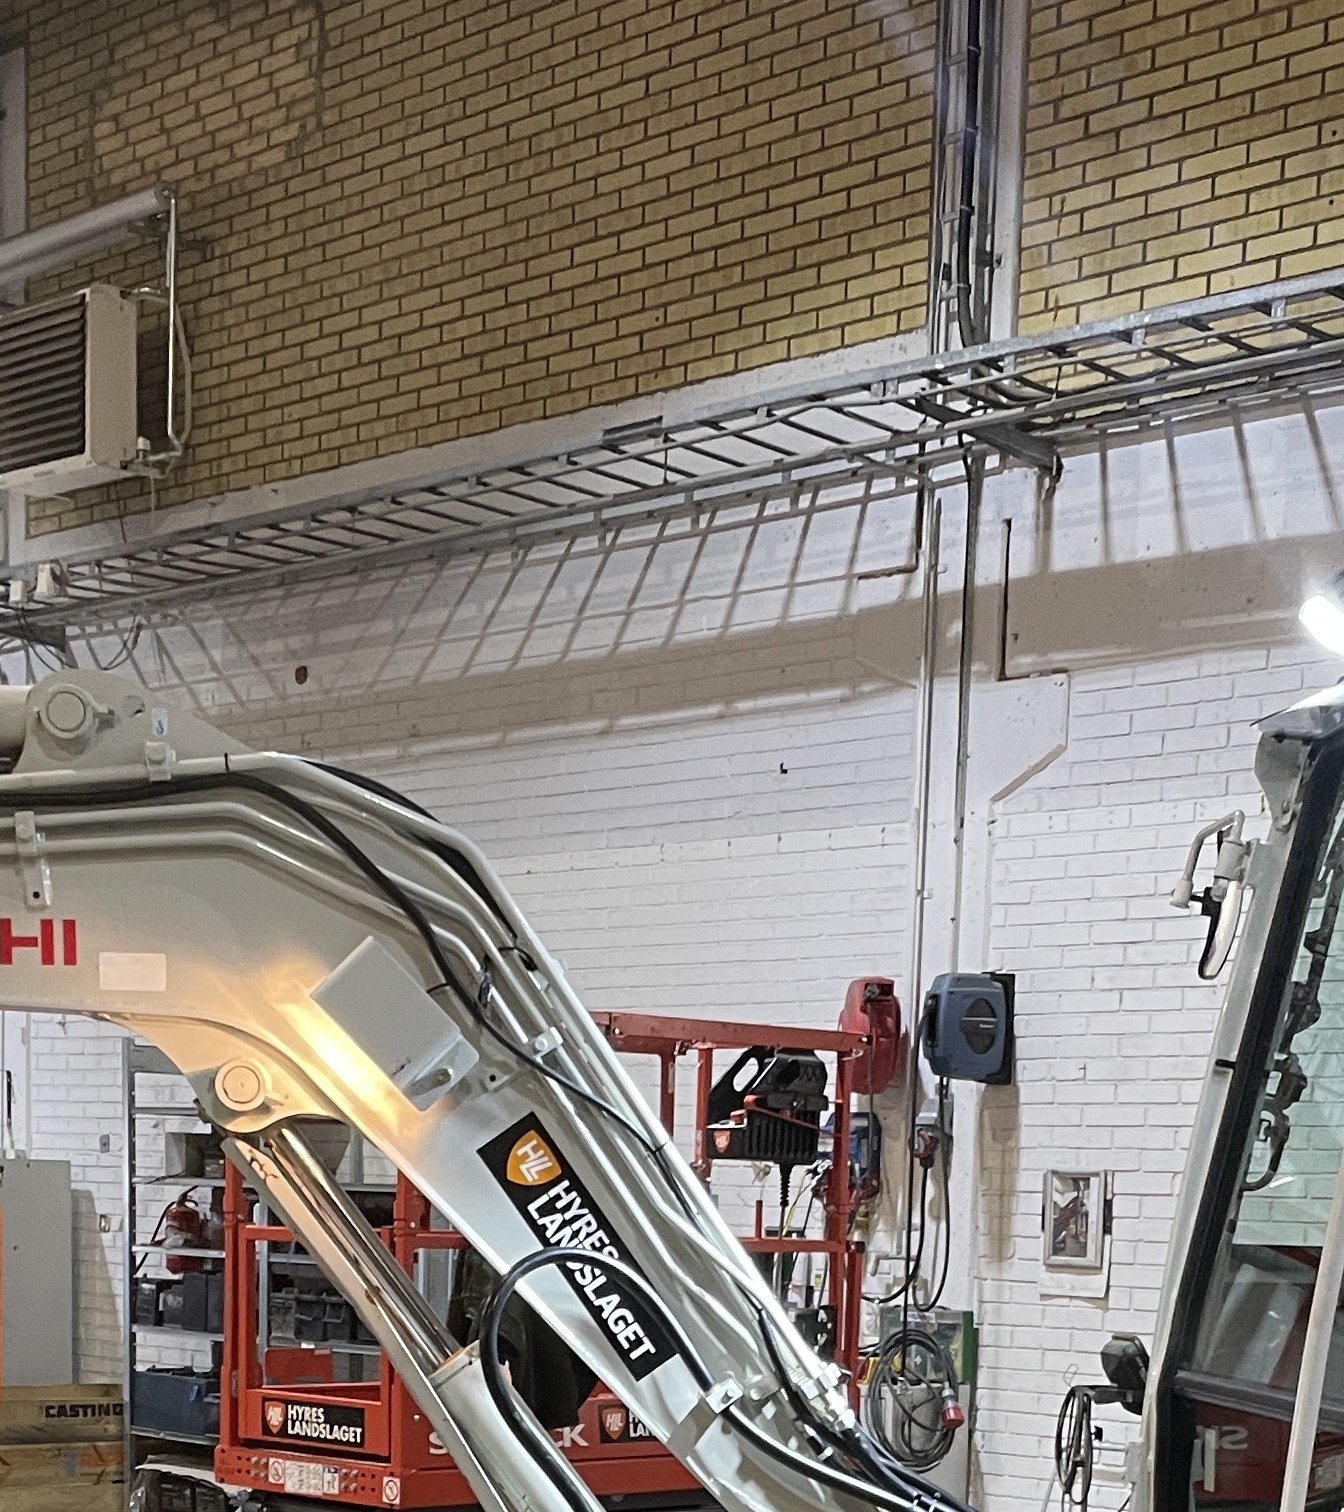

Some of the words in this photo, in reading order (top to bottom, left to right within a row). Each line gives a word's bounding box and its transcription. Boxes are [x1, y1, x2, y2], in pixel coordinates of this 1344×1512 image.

[548, 1179, 619, 1262] HYRES
[287, 1404, 325, 1423] HYRES
[287, 1419, 362, 1443] LANDSLAGET
